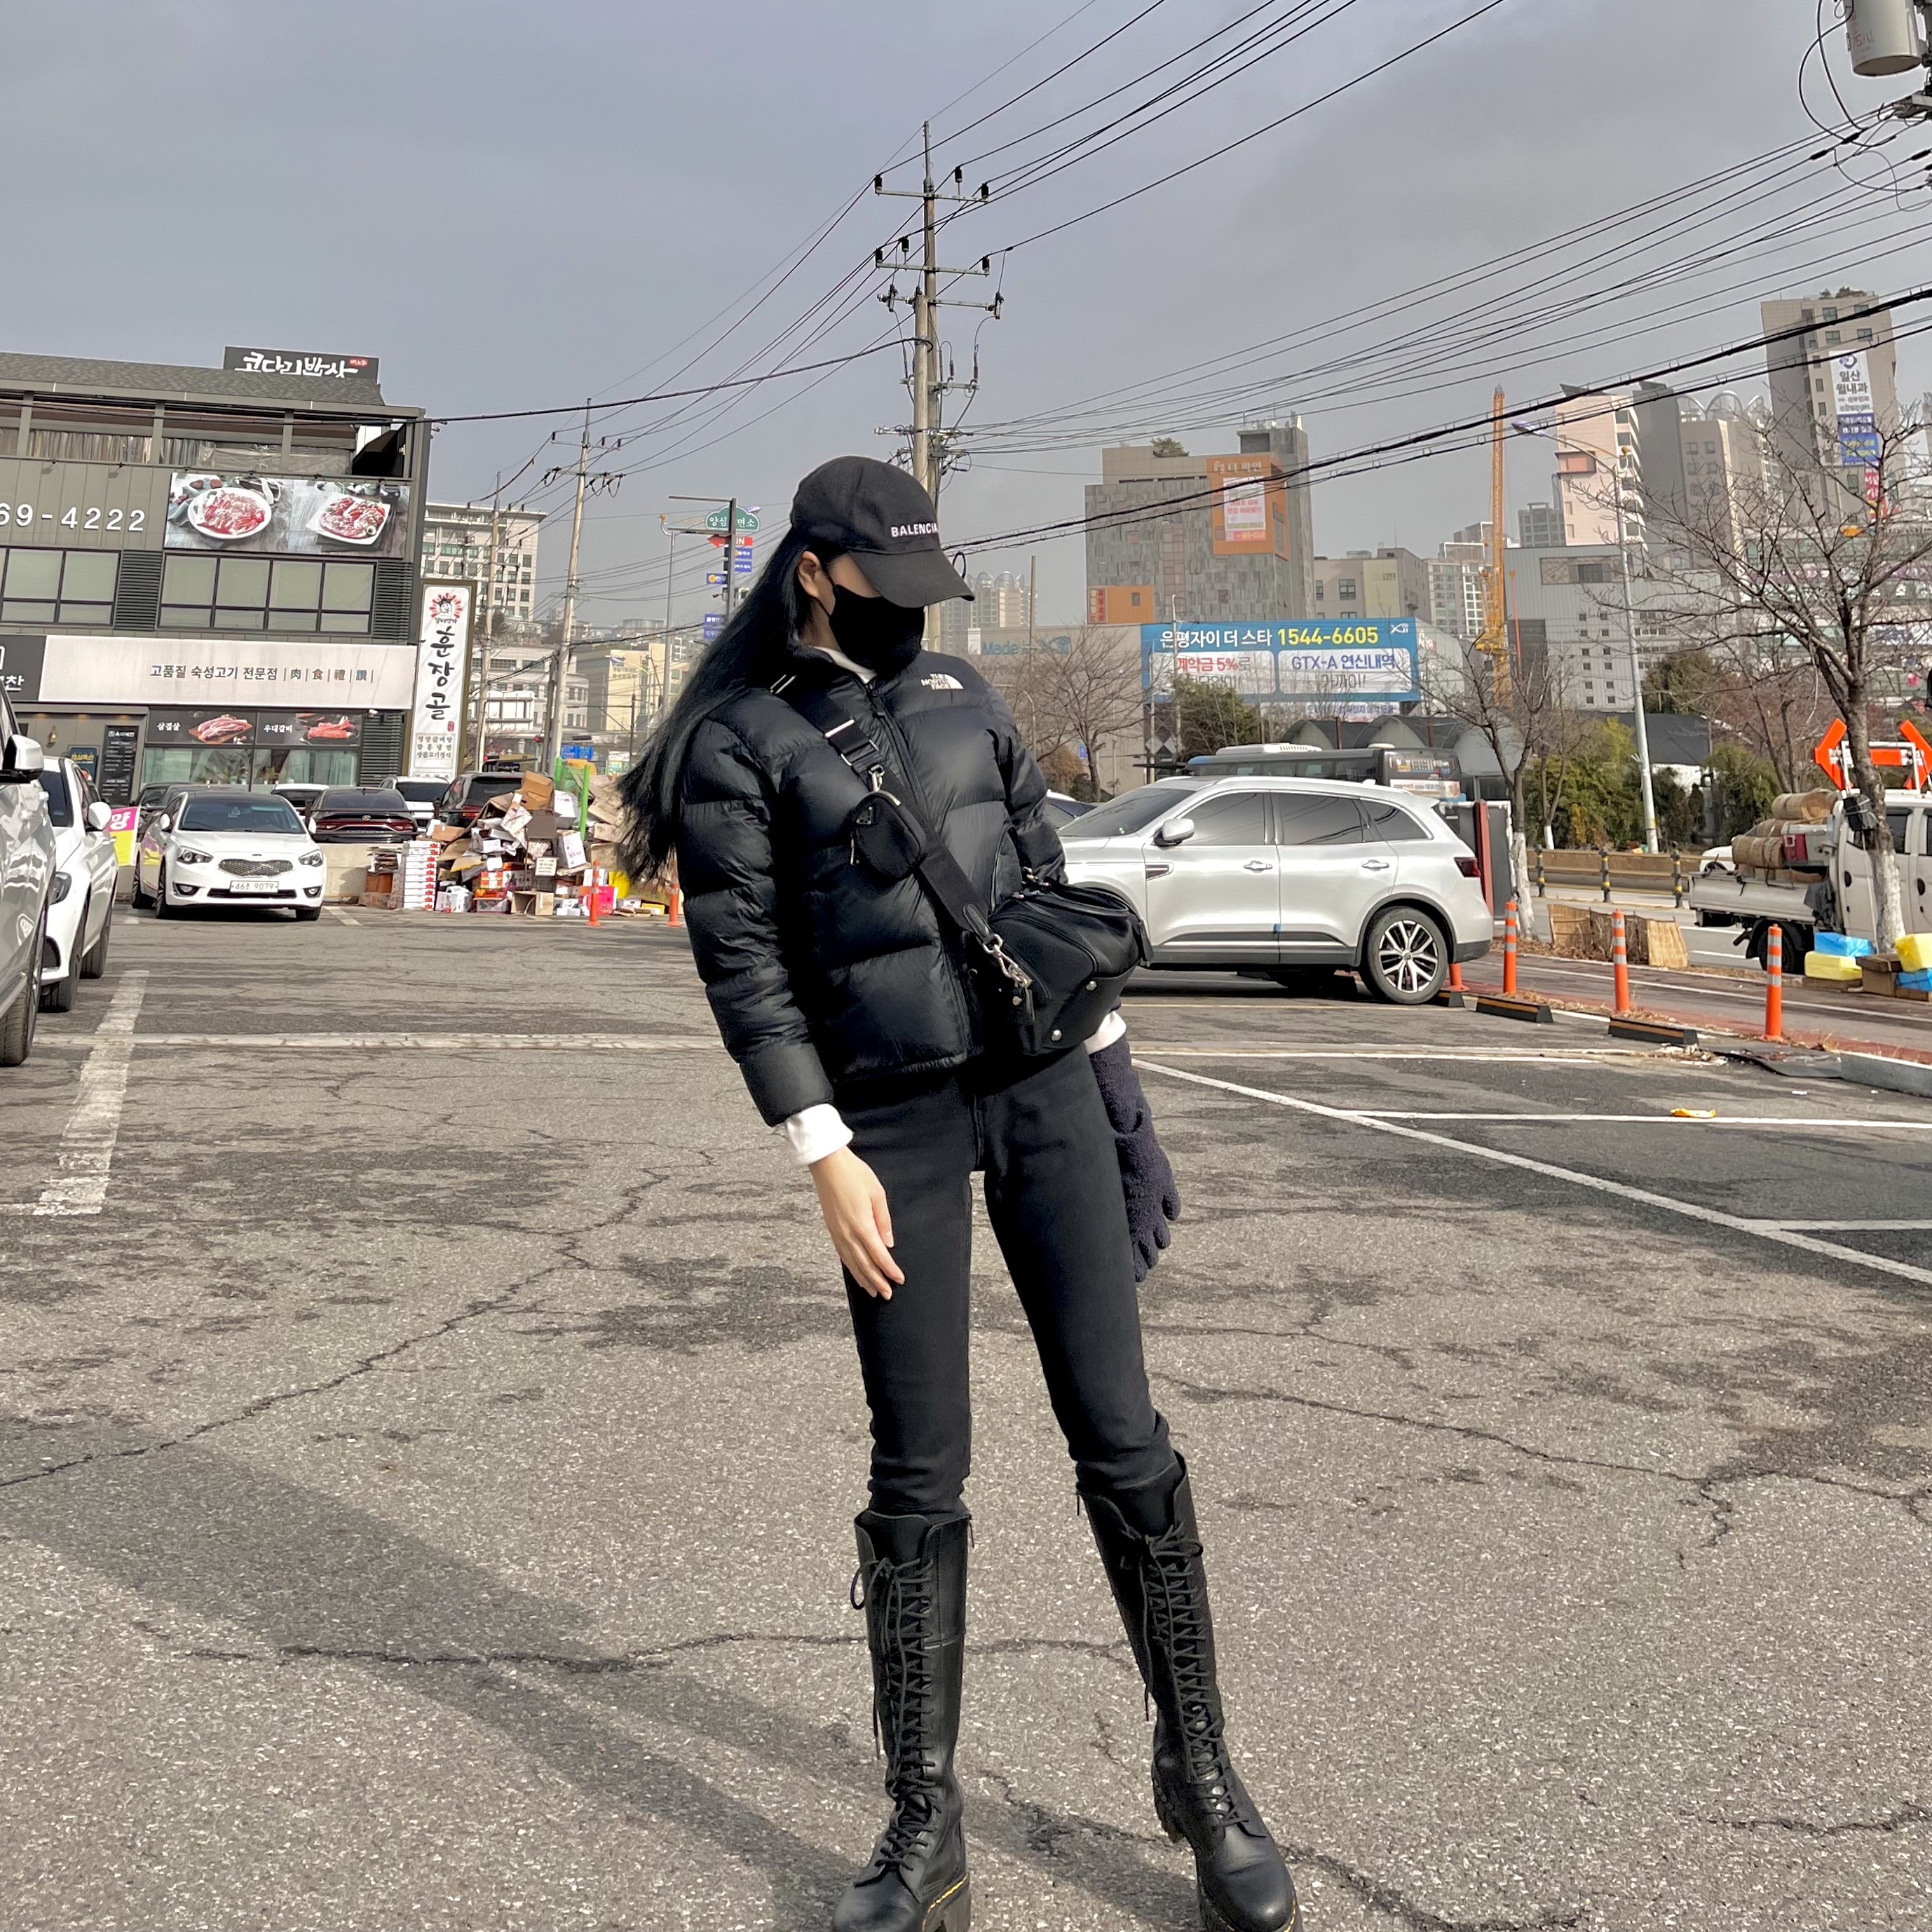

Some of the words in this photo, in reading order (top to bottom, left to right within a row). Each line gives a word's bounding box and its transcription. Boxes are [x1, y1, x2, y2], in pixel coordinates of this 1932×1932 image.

[1839, 370, 1861, 382] 일산
[1159, 630, 1220, 648] 은평자이
[1223, 629, 1238, 647] 더
[1241, 628, 1272, 646] 스타
[1277, 627, 1379, 646] 1544-6605
[981, 640, 1017, 655] Made
[1177, 657, 1213, 672] 계약금
[1217, 656, 1251, 672] 5%로
[1291, 656, 1338, 670] GTX-A
[1340, 654, 1395, 669] 연신내역
[149, 665, 186, 678] 고품질
[191, 666, 238, 679] 숙성고기
[243, 667, 278, 681] 전문점
[426, 626, 455, 720] 훈장골
[264, 724, 293, 733] 우대갈비
[254, 883, 273, 891] 9079
